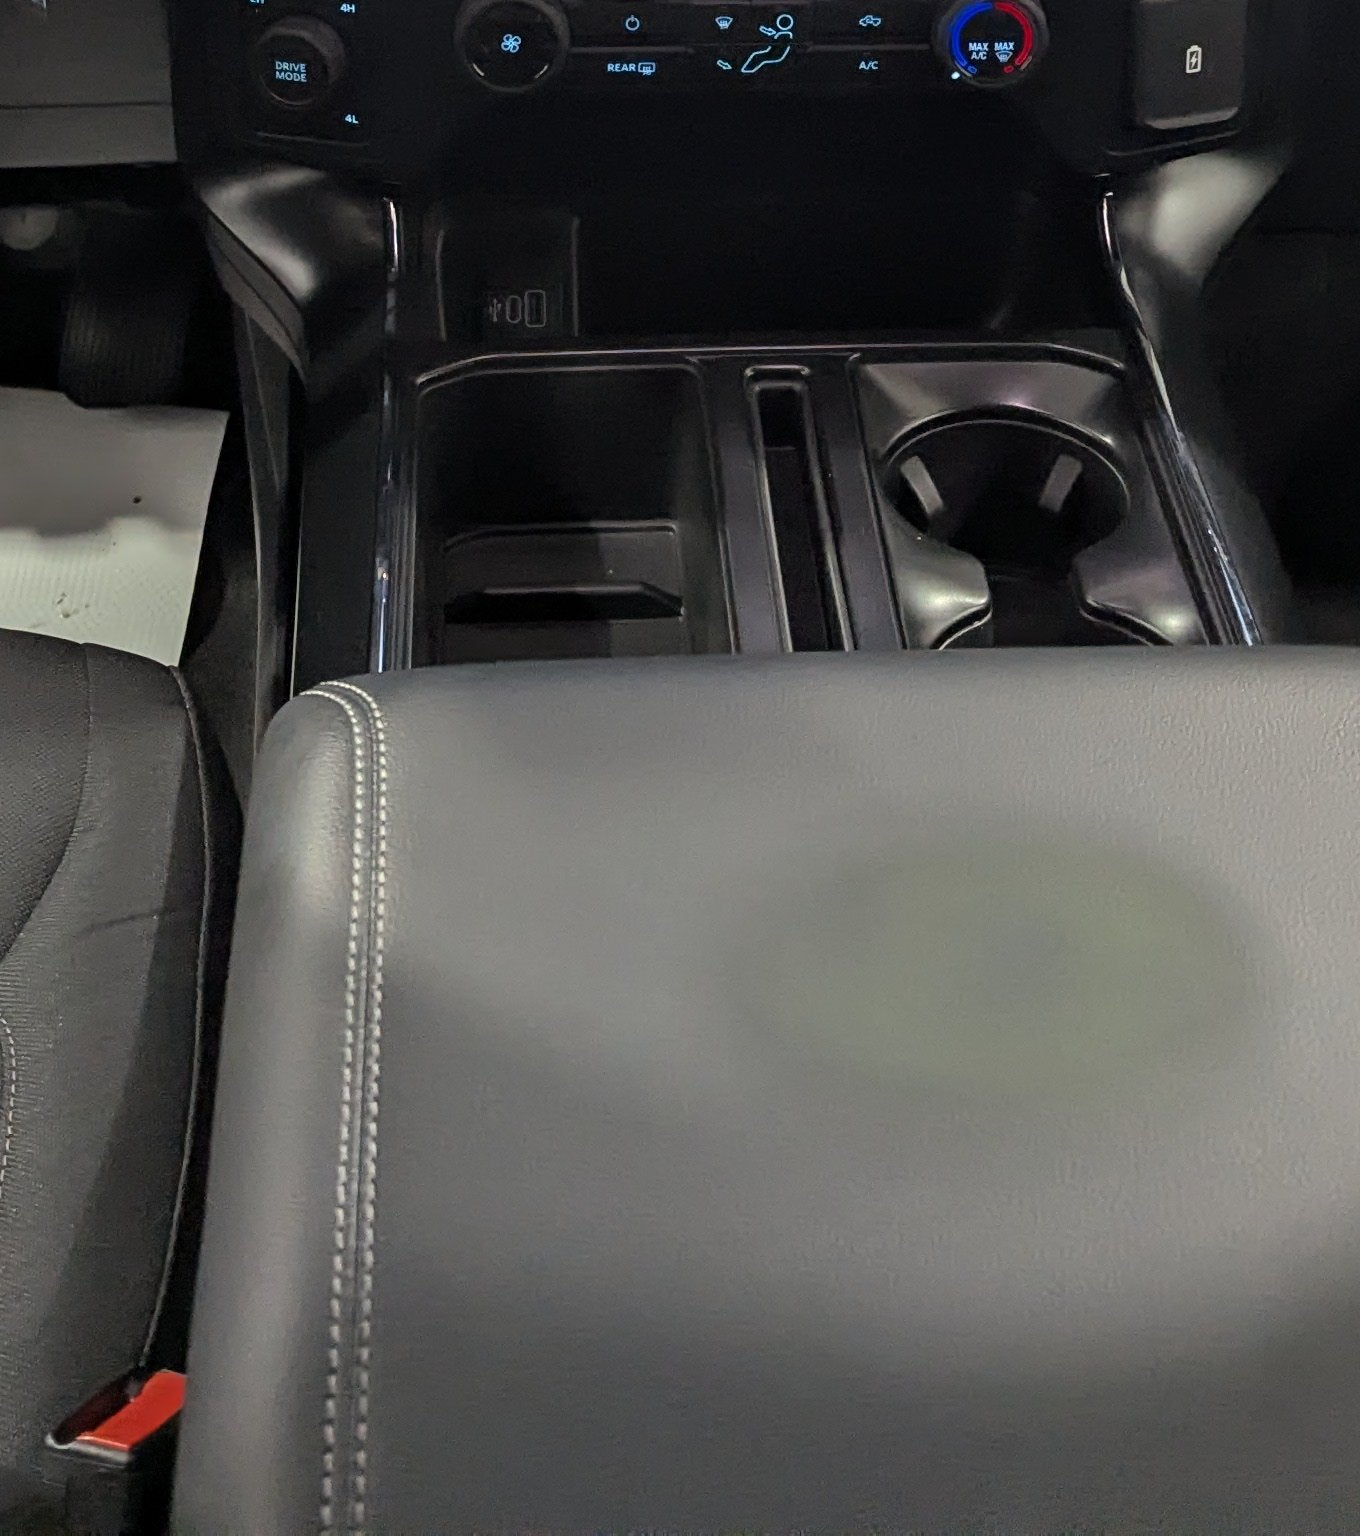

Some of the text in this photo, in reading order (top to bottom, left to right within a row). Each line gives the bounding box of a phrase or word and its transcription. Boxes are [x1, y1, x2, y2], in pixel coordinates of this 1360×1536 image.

[340, 3, 356, 13] 4H
[968, 42, 989, 52] MAX
[994, 41, 1015, 52] MAX
[971, 51, 988, 61] A/C
[275, 61, 307, 73] DRIVE
[607, 63, 636, 72] REAR
[858, 61, 879, 71] A/C
[275, 70, 307, 83] MODE
[344, 113, 359, 124] 4L
